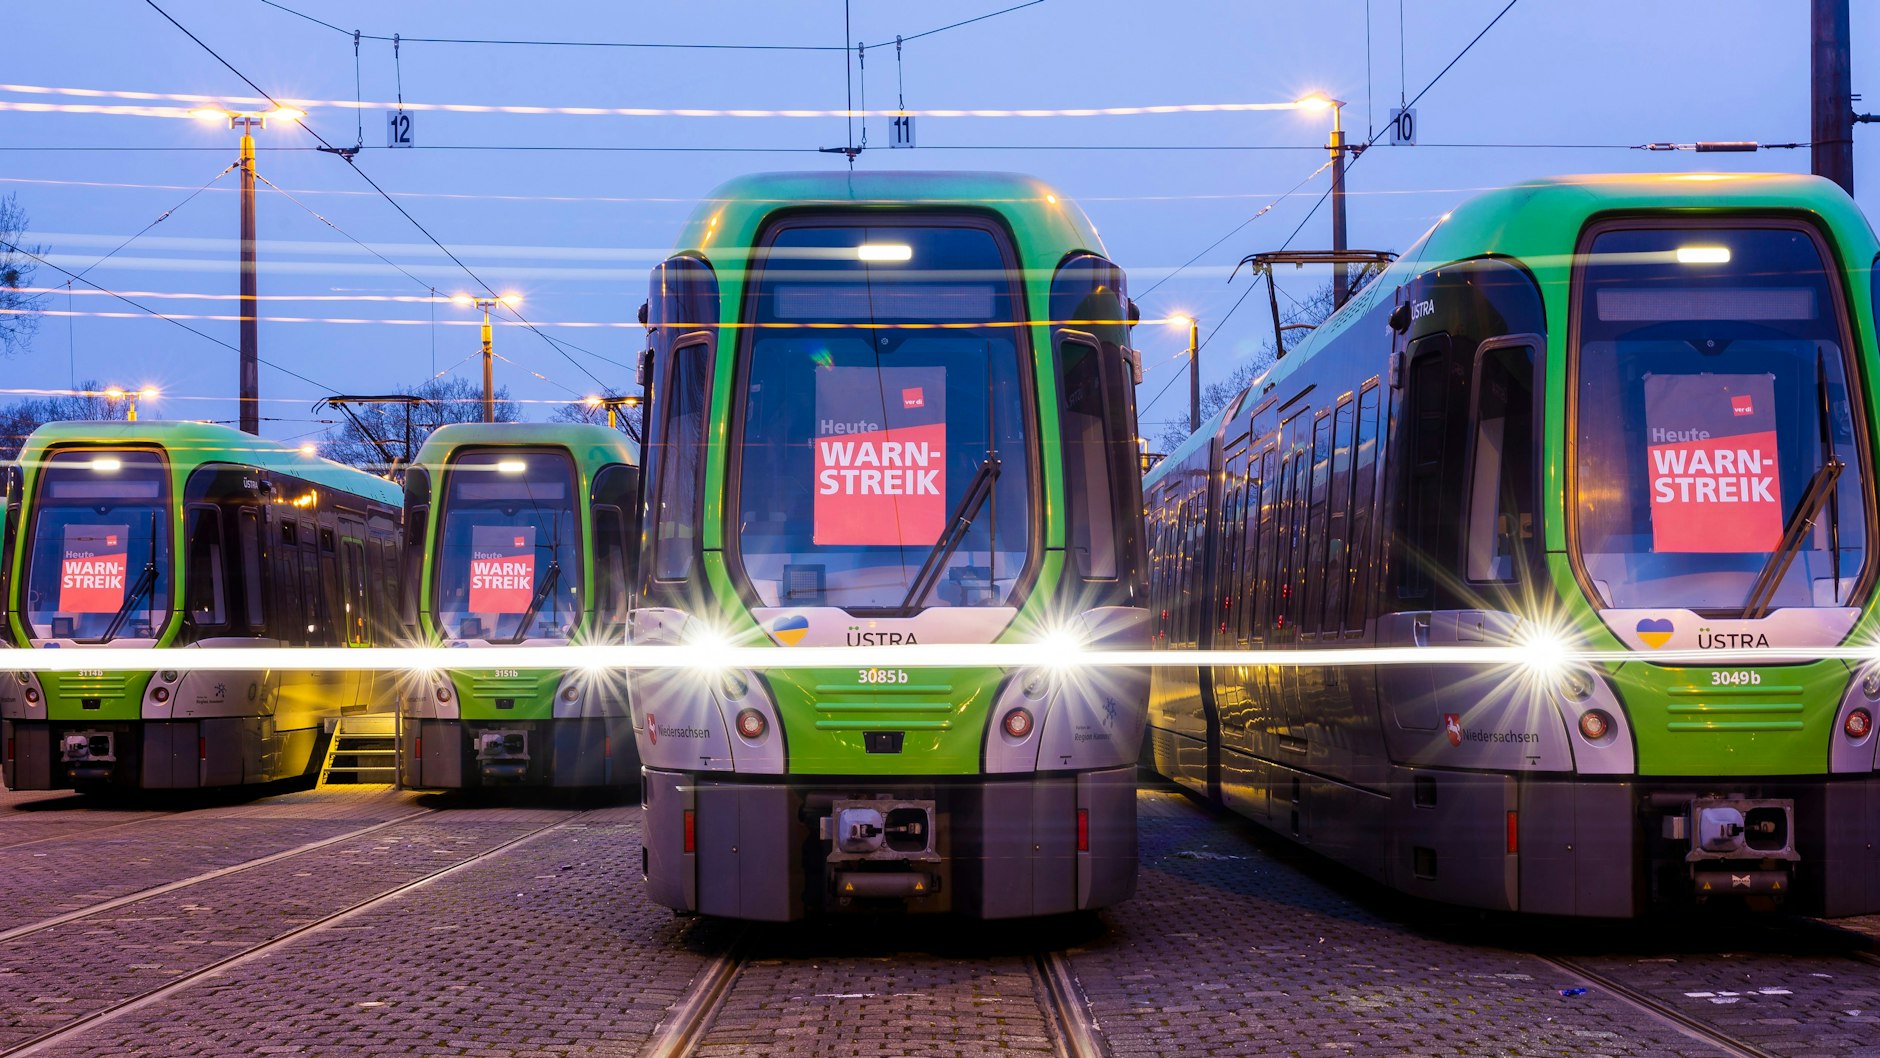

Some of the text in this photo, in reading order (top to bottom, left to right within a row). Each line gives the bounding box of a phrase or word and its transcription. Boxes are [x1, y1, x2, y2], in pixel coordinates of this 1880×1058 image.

[391, 115, 410, 143] 12
[894, 116, 909, 143] 11
[1394, 113, 1412, 141] 10
[1411, 299, 1435, 321] ÜSTRA
[821, 420, 879, 434] Heute
[1652, 428, 1710, 442] Heute
[820, 441, 941, 467] WARN-
[1653, 449, 1773, 475] WARN-
[820, 469, 940, 495] STREIK
[1654, 477, 1775, 503] STREIK
[65, 550, 95, 559] Heute
[474, 551, 502, 559] Heute
[65, 561, 124, 575] WARN-
[473, 562, 532, 575] WARN-
[63, 575, 122, 589] STREIK
[472, 576, 531, 589] STREIK
[847, 626, 918, 647] ÜSTRA
[1698, 627, 1770, 650] ÜSTRA
[658, 725, 710, 739] Niedersachsen
[1462, 729, 1539, 743] Niedersachsen
